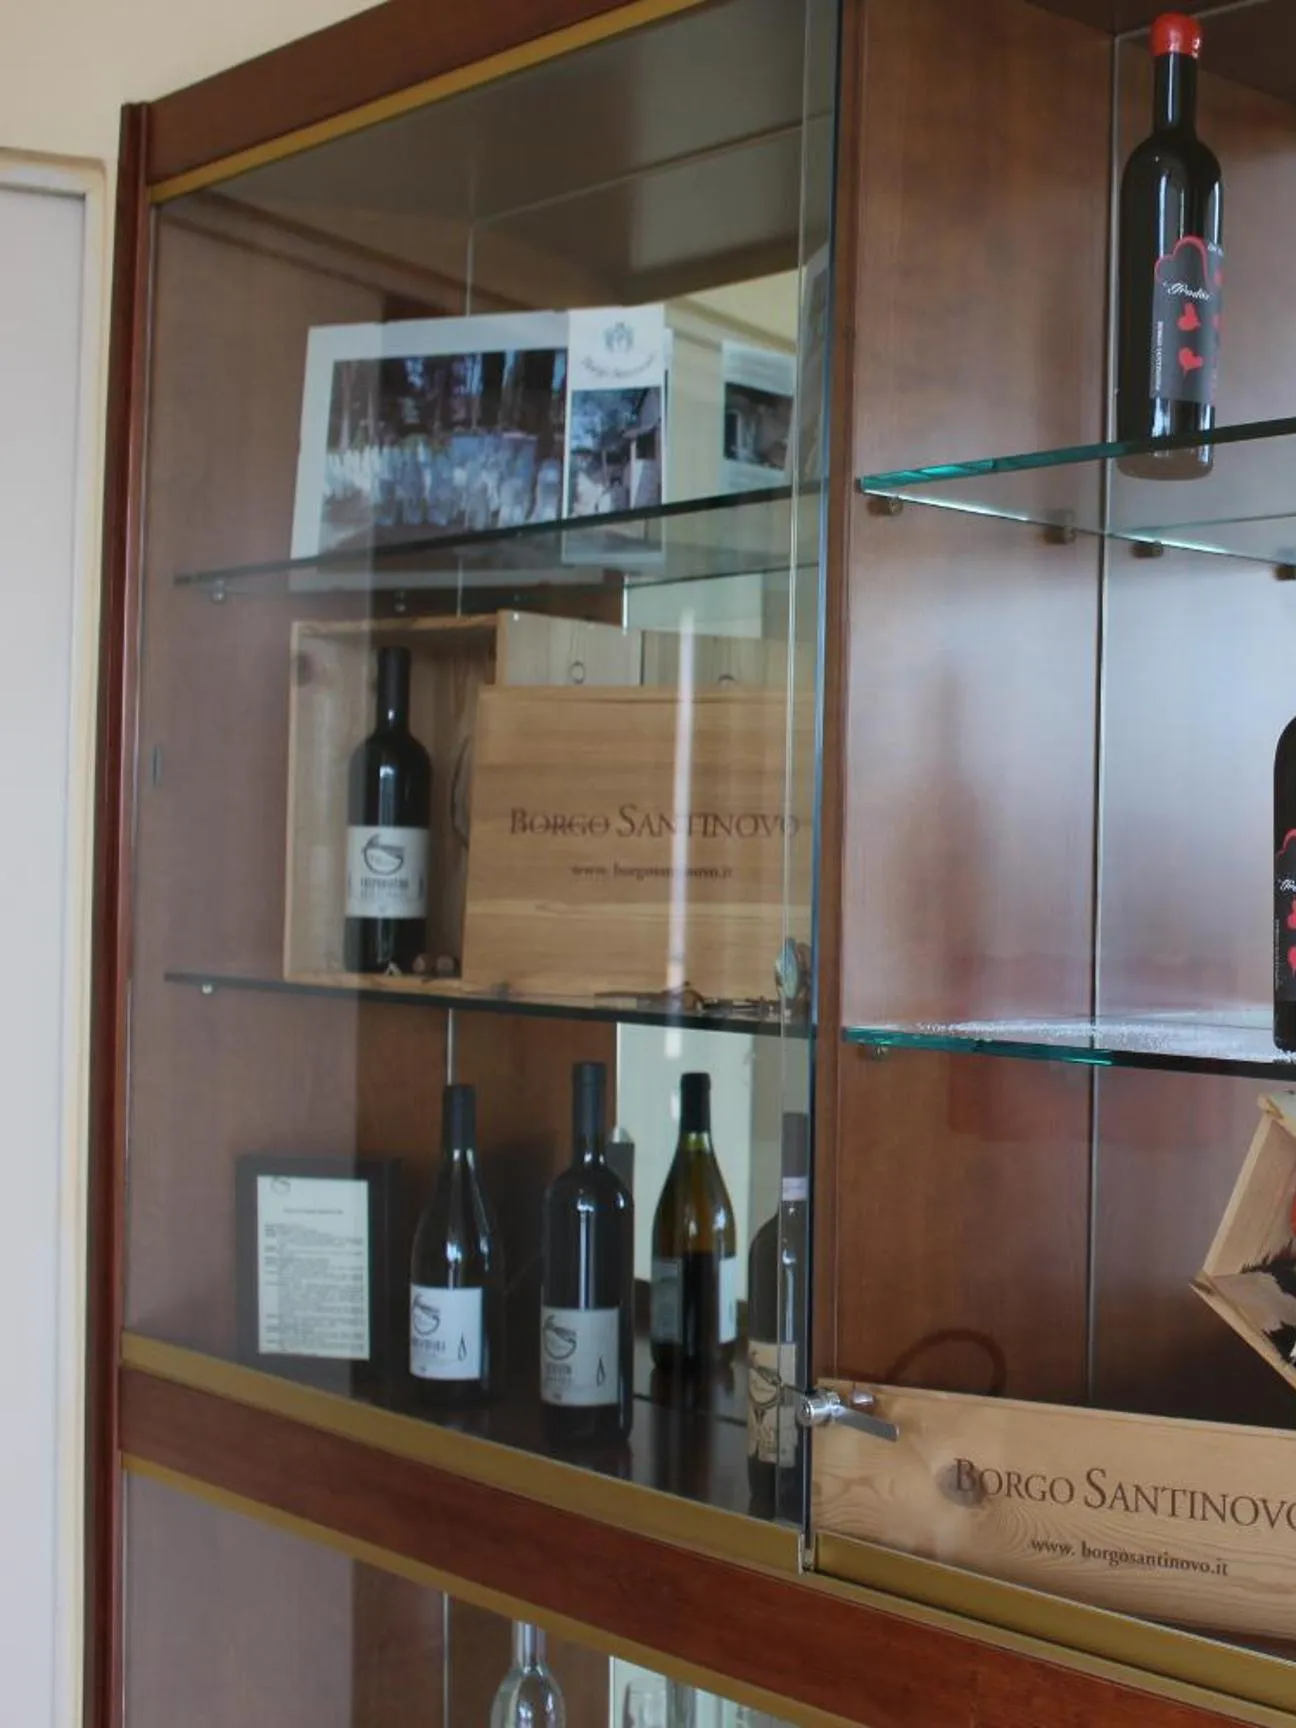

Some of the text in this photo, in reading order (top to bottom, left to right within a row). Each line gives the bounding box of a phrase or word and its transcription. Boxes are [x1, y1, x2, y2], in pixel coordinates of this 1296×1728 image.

[509, 803, 800, 839] BORGO SANTINOVO
[953, 1457, 1075, 1506] BORGO
[1030, 1538, 1229, 1576] www. borgosantinovo.it
